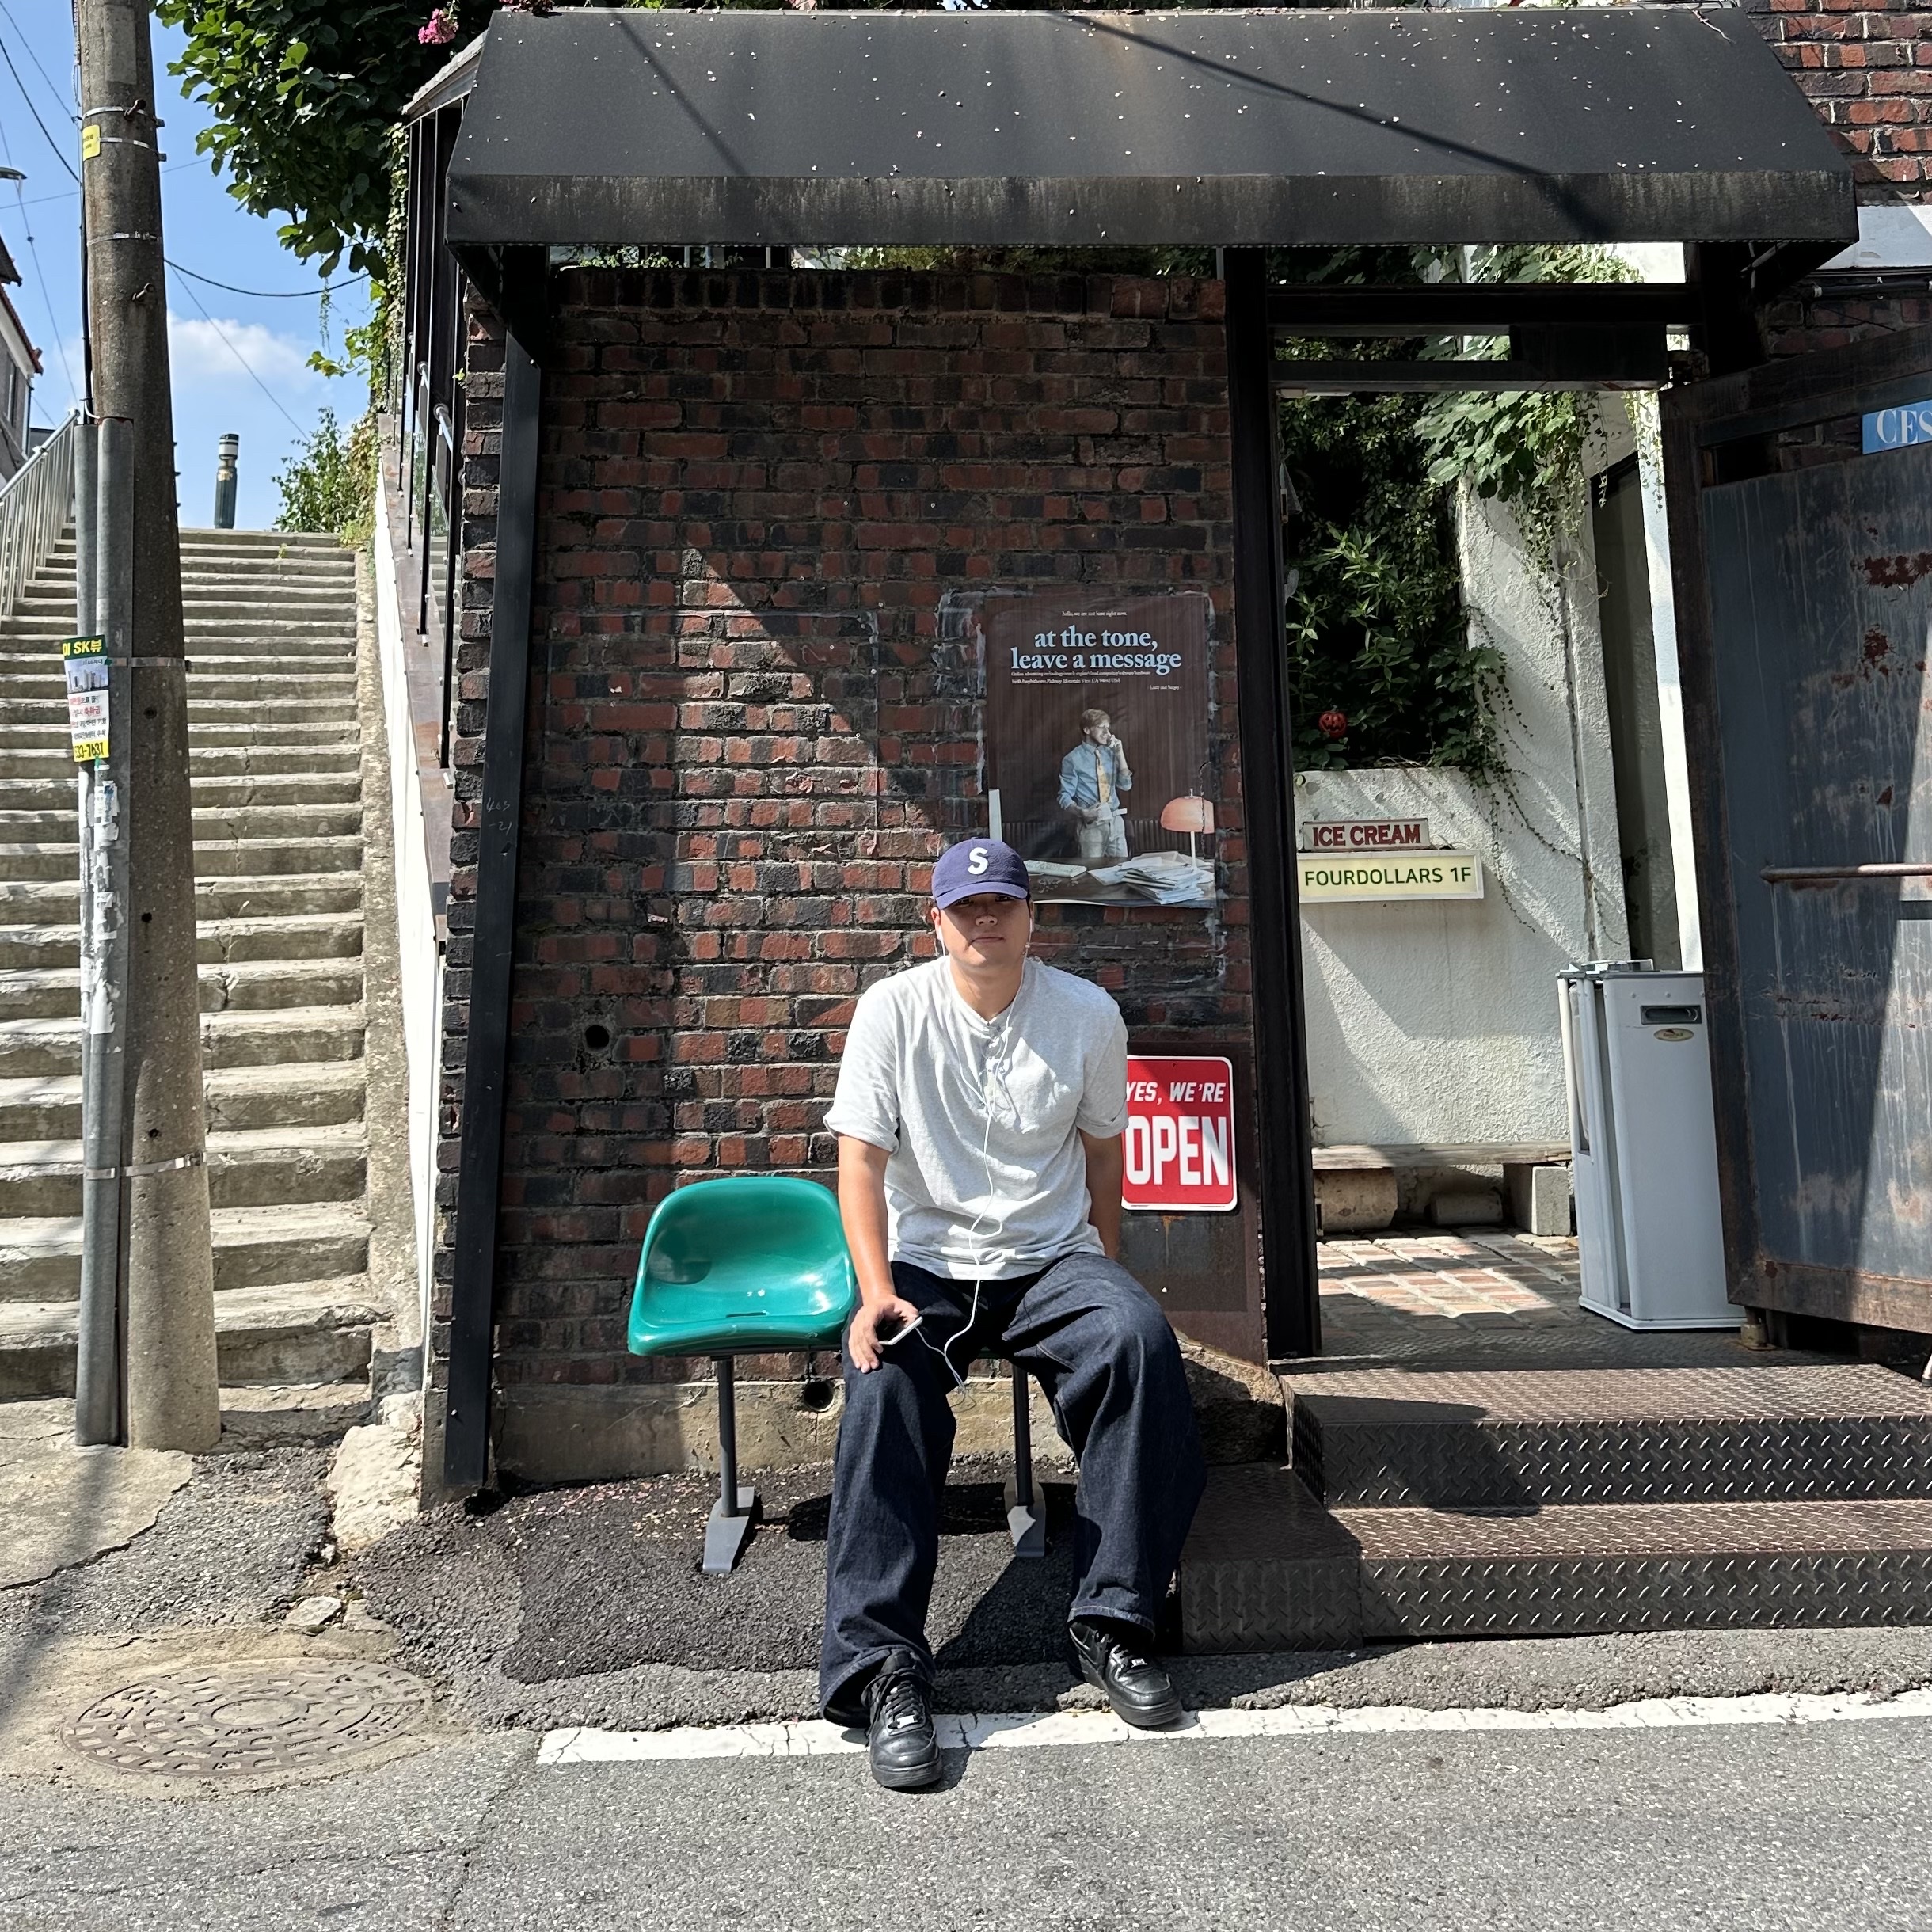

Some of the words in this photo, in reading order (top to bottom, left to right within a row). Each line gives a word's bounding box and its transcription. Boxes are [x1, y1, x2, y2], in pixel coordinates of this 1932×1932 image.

[1034, 631, 1056, 648] at
[1060, 625, 1097, 648] the
[1101, 630, 1158, 651] tone,
[1010, 647, 1068, 669] leave
[1073, 654, 1085, 669] a
[1090, 652, 1181, 675] message
[1313, 826, 1346, 846] ICE
[1350, 823, 1421, 846] CREAM
[968, 847, 988, 875] S
[1305, 868, 1443, 886] FOURDOLLARS
[1450, 867, 1472, 883] 1F
[1126, 1081, 1162, 1105] YES,
[1169, 1082, 1227, 1103] WE'RE
[1125, 1116, 1229, 1186] OPEN
